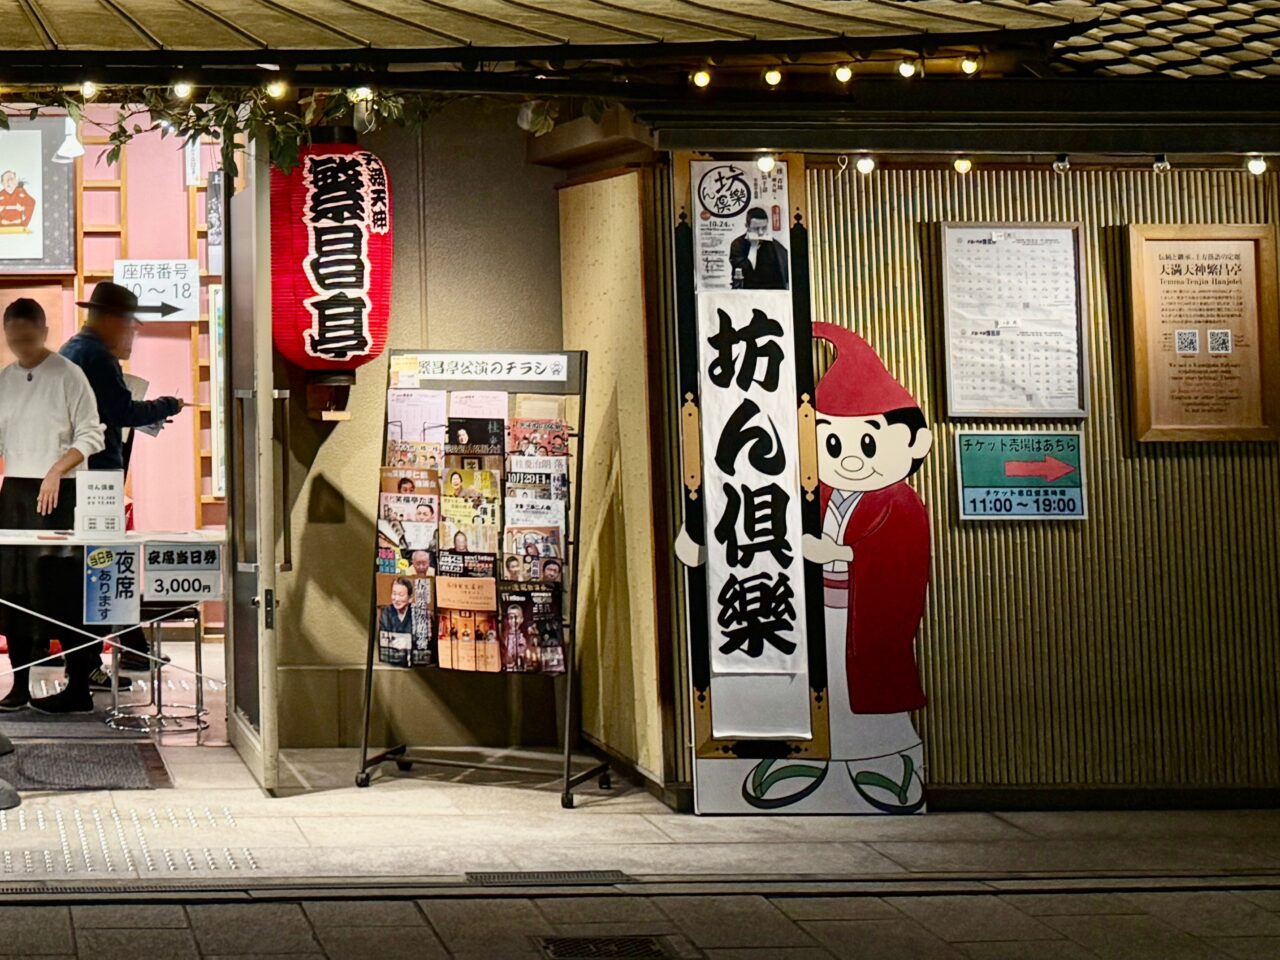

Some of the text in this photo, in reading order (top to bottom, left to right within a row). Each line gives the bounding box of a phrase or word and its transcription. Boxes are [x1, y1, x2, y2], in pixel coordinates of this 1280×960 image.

[310, 155, 369, 357] 繁昌亭
[123, 263, 189, 280] 座席番号
[1160, 263, 1242, 277] 天満天神繁昌亭
[963, 437, 1077, 454] チケット売場はあちら
[148, 551, 217, 566] 夜席当日券
[115, 550, 135, 600] 夜席
[98, 570, 112, 620] あります
[154, 578, 211, 596] 3,000円
